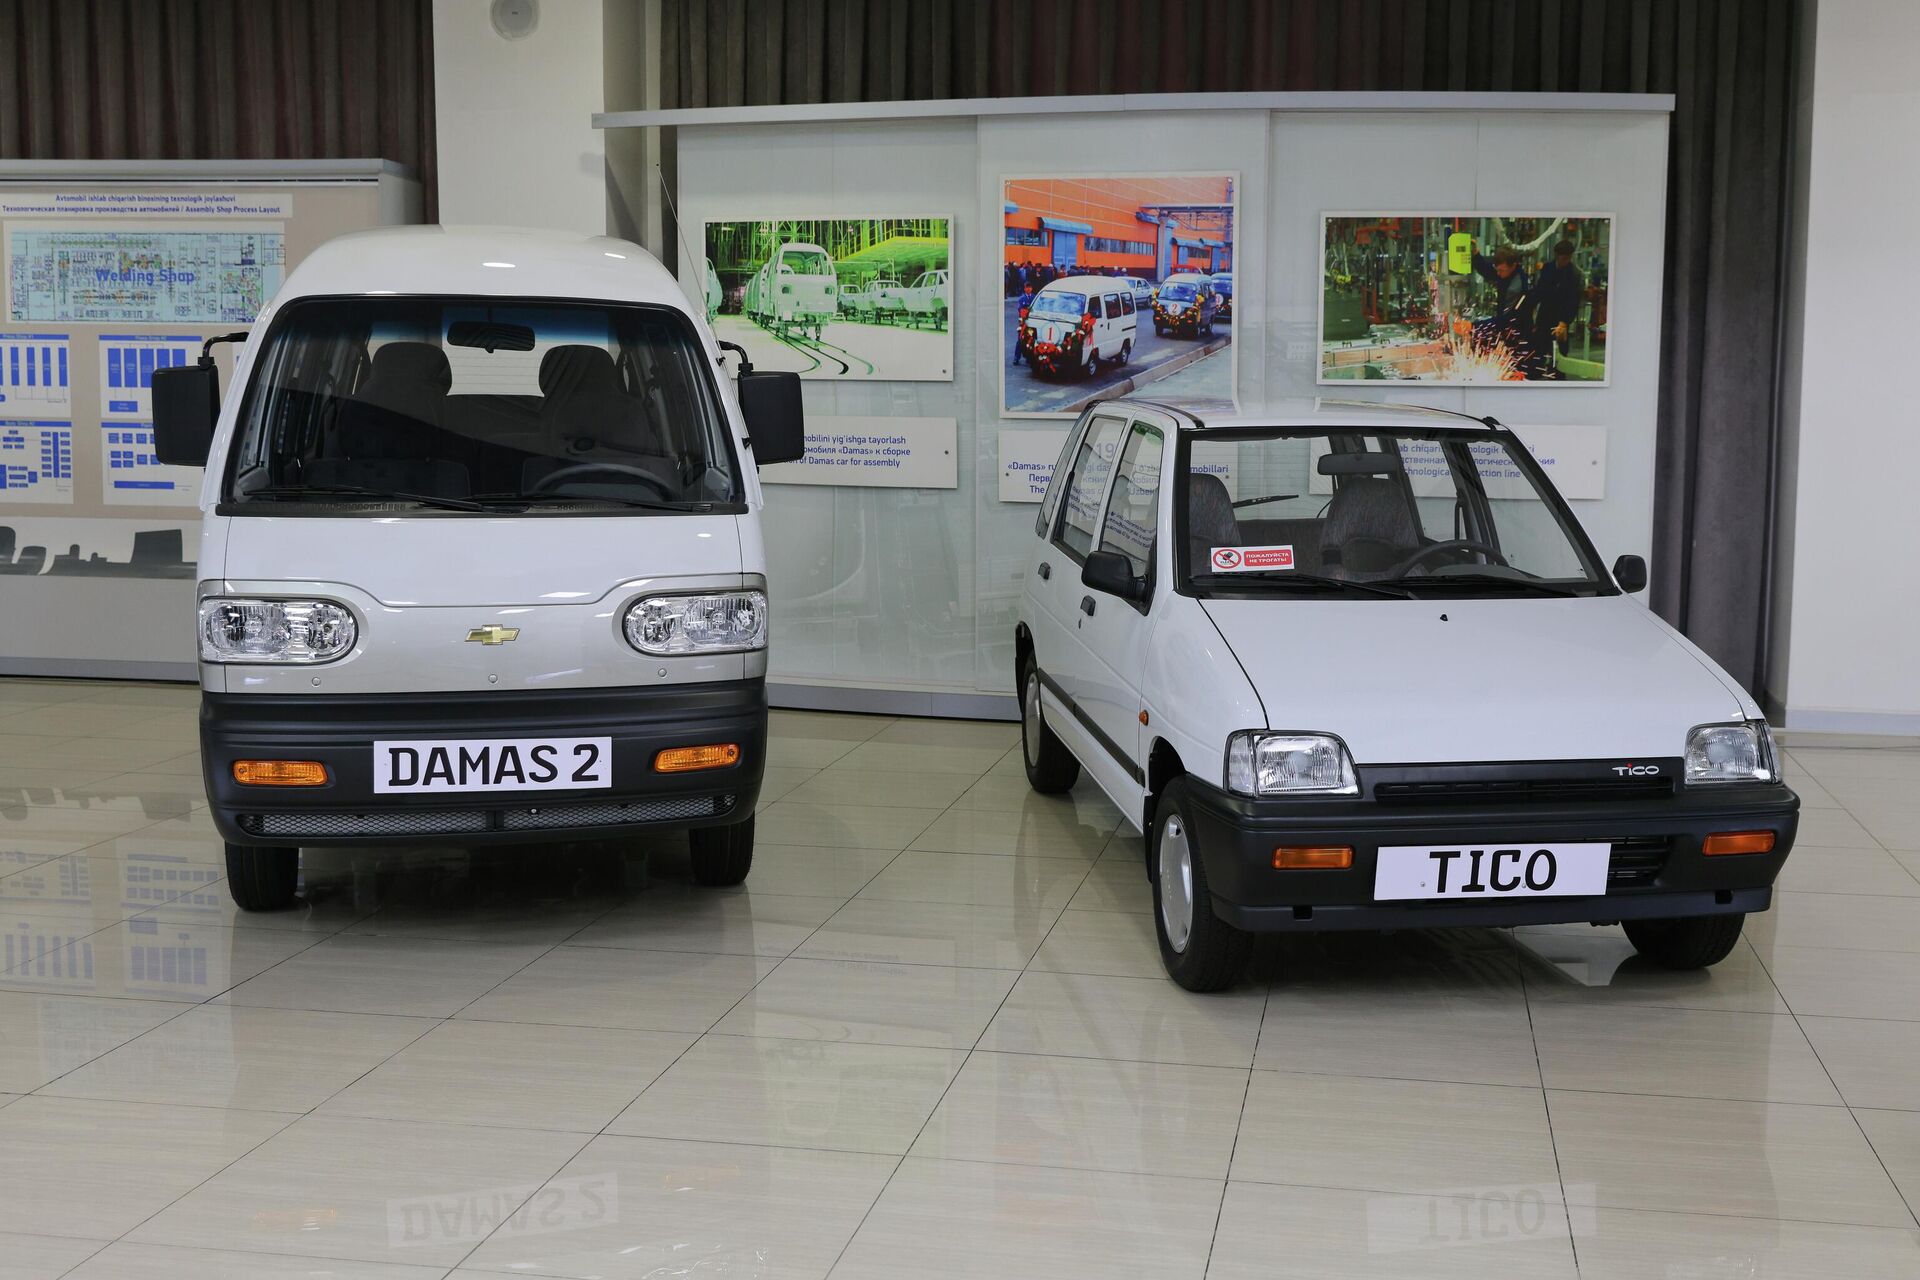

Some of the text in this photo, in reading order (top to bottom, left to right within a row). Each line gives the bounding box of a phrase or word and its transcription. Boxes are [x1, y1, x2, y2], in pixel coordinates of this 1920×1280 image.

[185, 206, 215, 214] Assembly
[216, 206, 232, 214] Shop
[259, 206, 280, 214] Layout
[95, 268, 195, 285] Welding Shop
[804, 434, 906, 445] obilini yig'ishga tayorlash
[882, 447, 911, 456] сборке
[1097, 443, 1114, 458] 19
[808, 456, 835, 465] Damas
[850, 457, 861, 465] for
[863, 458, 901, 468] assembly
[1402, 456, 1445, 465] ственная
[1190, 464, 1229, 473] mobillari
[1504, 469, 1521, 478] line
[1029, 473, 1051, 483] Перв
[1029, 485, 1045, 494] The
[389, 743, 599, 786] DAMAS 2
[1429, 849, 1557, 894] TICO
